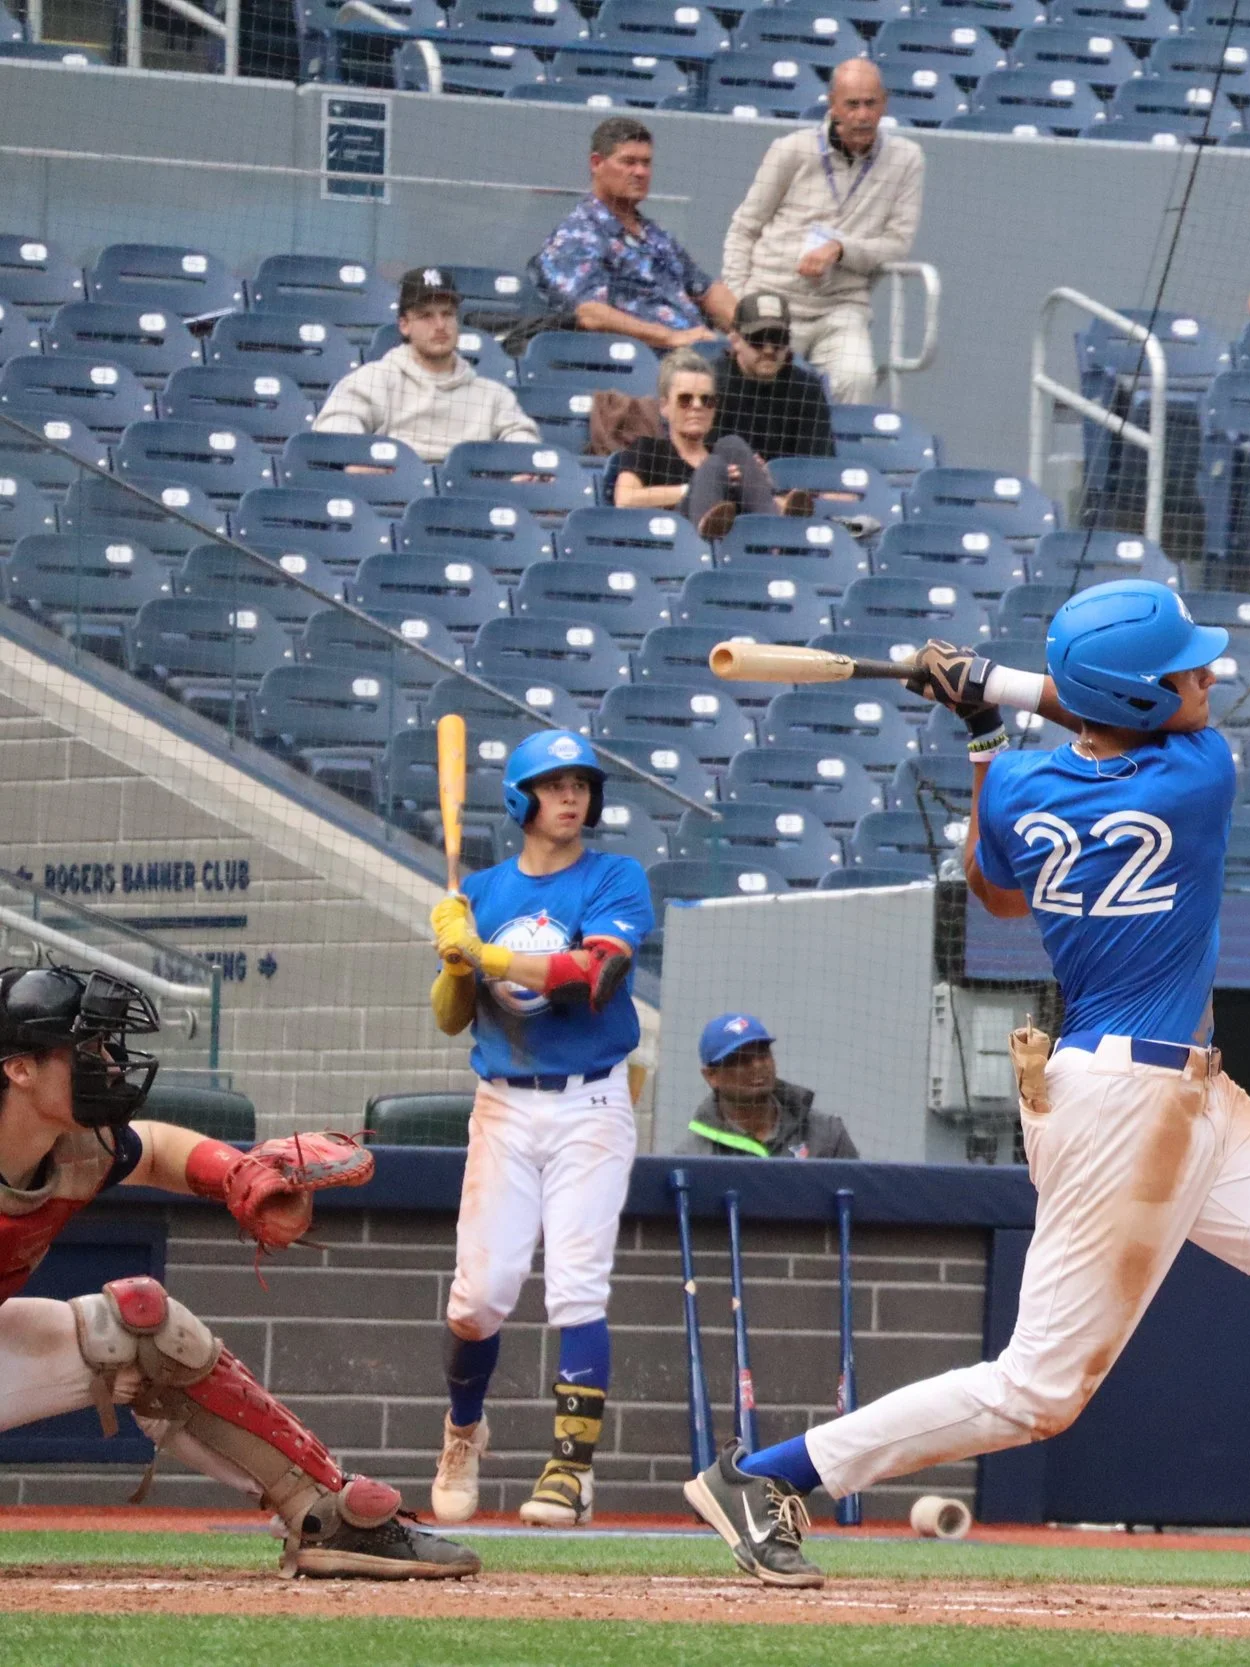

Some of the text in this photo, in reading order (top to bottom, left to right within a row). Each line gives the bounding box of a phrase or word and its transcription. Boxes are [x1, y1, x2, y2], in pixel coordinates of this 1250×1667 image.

[44, 859, 250, 895] ROGERS BANNER CLUB
[1013, 810, 1178, 917] 22
